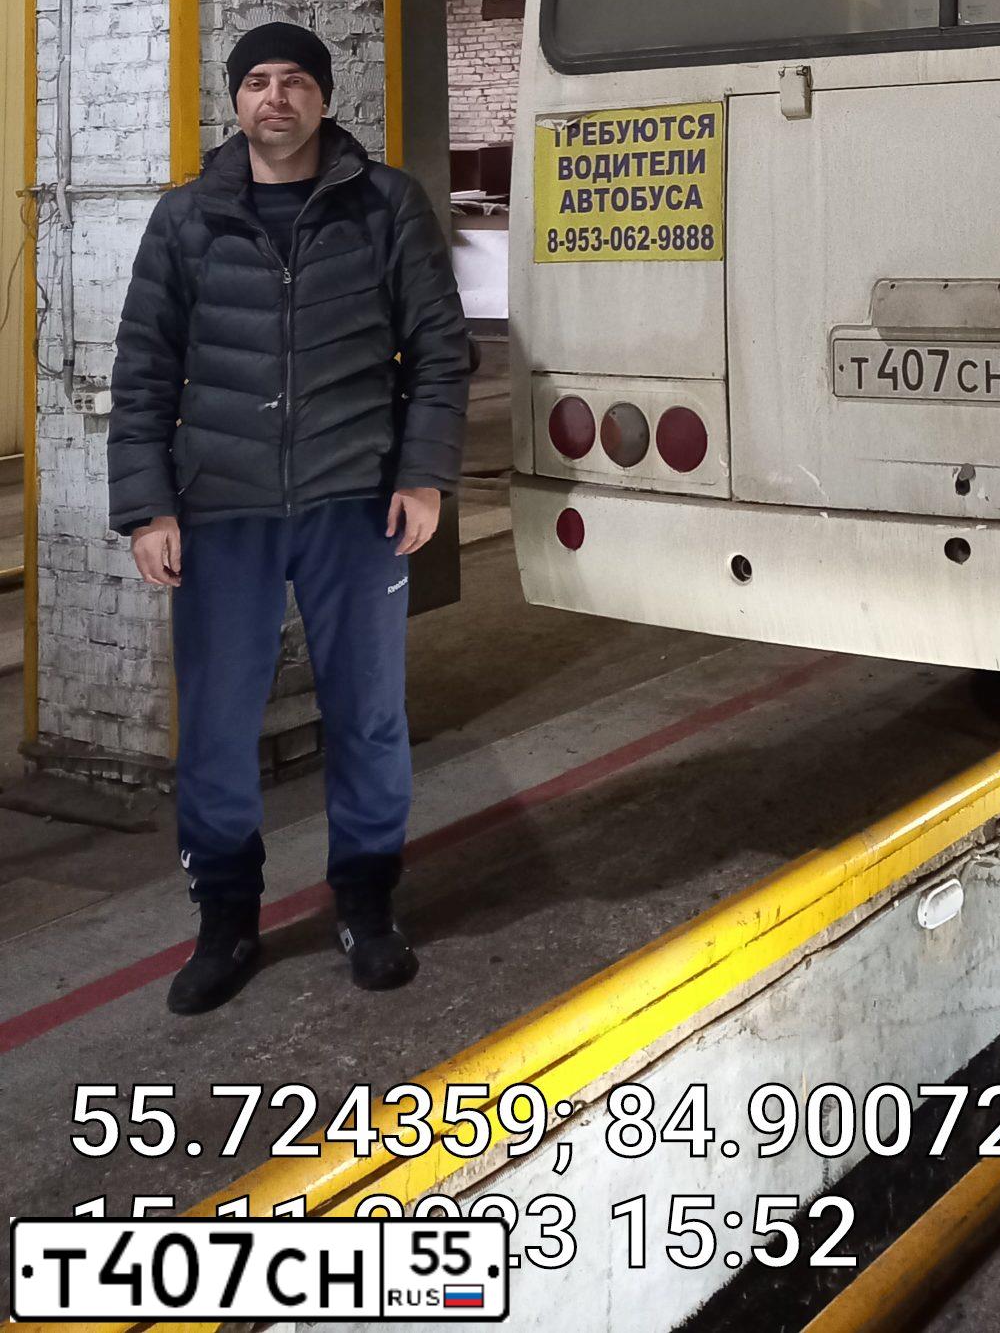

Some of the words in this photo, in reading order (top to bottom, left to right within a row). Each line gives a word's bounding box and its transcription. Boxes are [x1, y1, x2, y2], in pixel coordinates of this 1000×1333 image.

[558, 149, 705, 183] ВОДИТЕЛИ
[559, 184, 703, 214] АВТОБУСА
[547, 224, 714, 253] 8-953-062-9888
